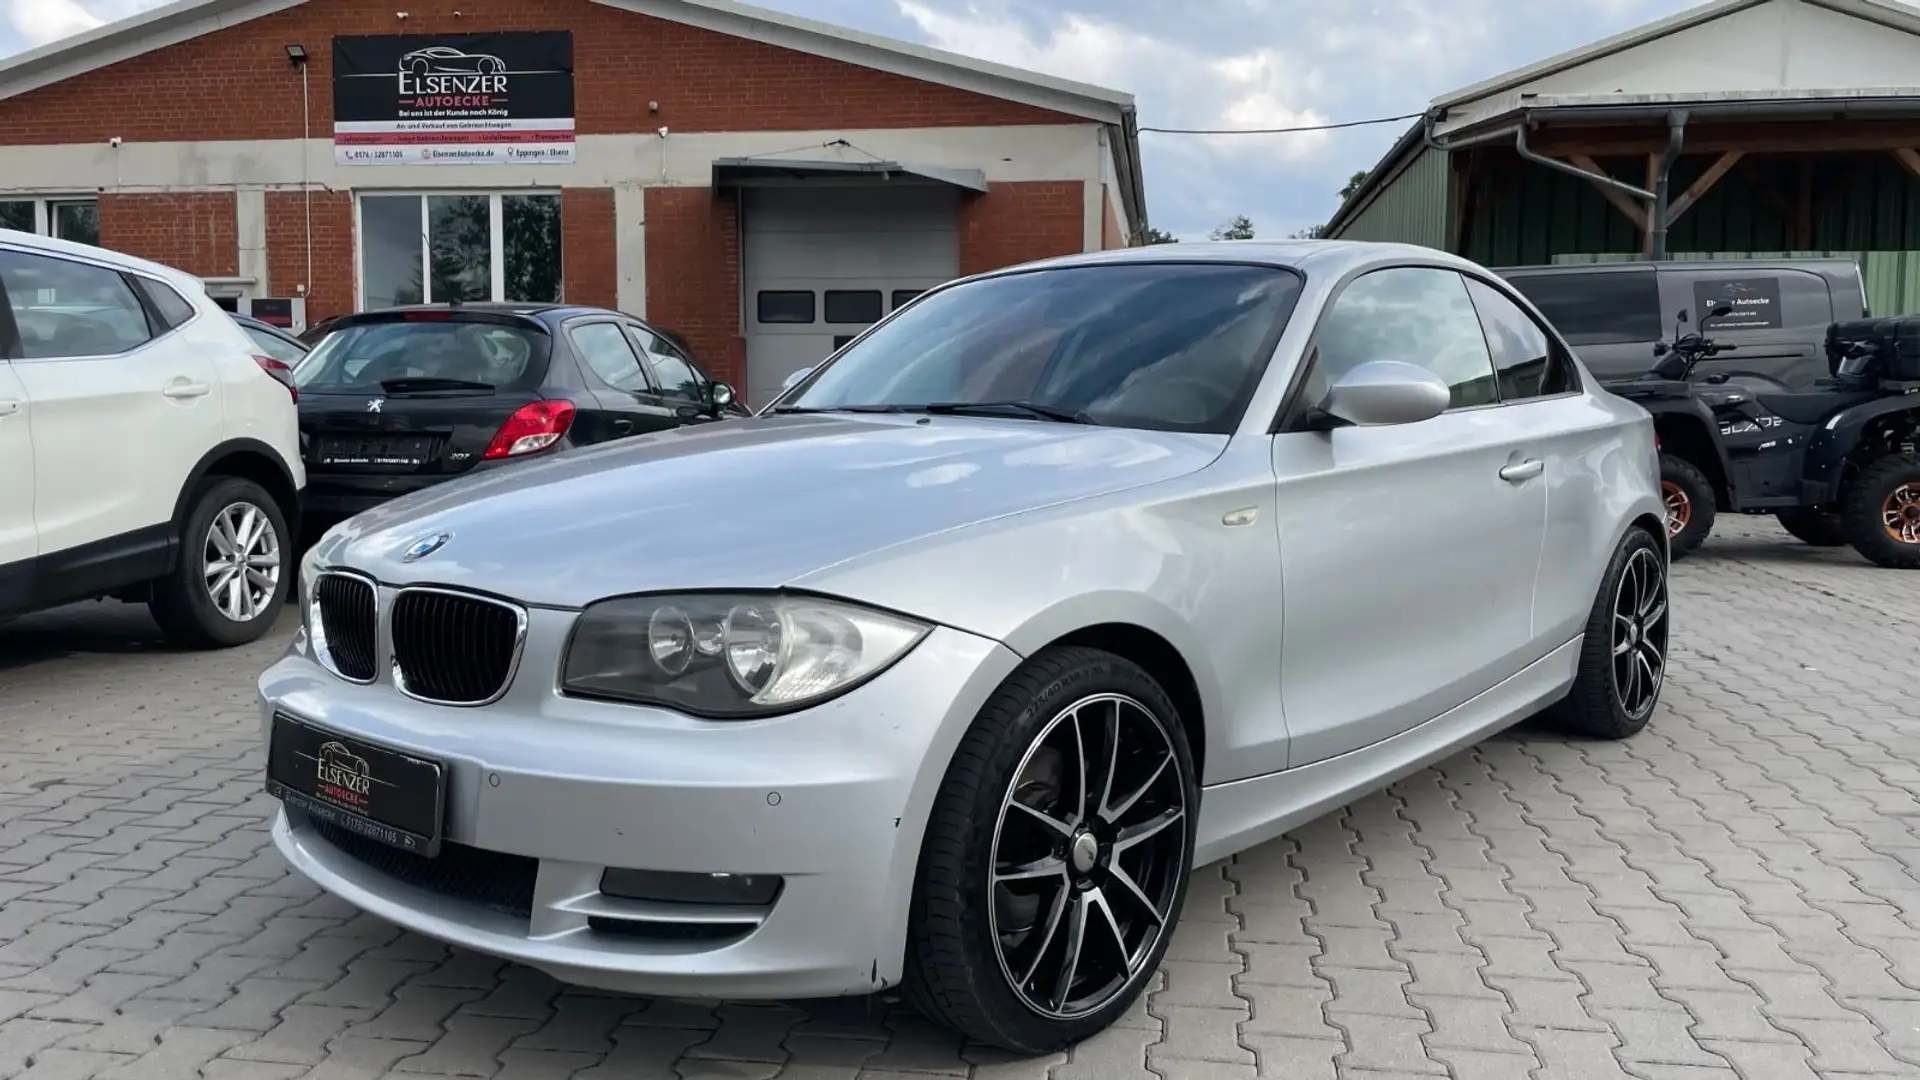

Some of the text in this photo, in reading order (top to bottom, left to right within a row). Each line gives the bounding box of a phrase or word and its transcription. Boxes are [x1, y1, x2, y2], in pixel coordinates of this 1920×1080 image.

[398, 70, 508, 95] ELSENZER
[415, 95, 490, 108] AUTOECKE
[433, 109, 446, 117] der
[446, 109, 469, 117] Kunde
[487, 107, 509, 117] König
[317, 757, 370, 796] ELSENZER
